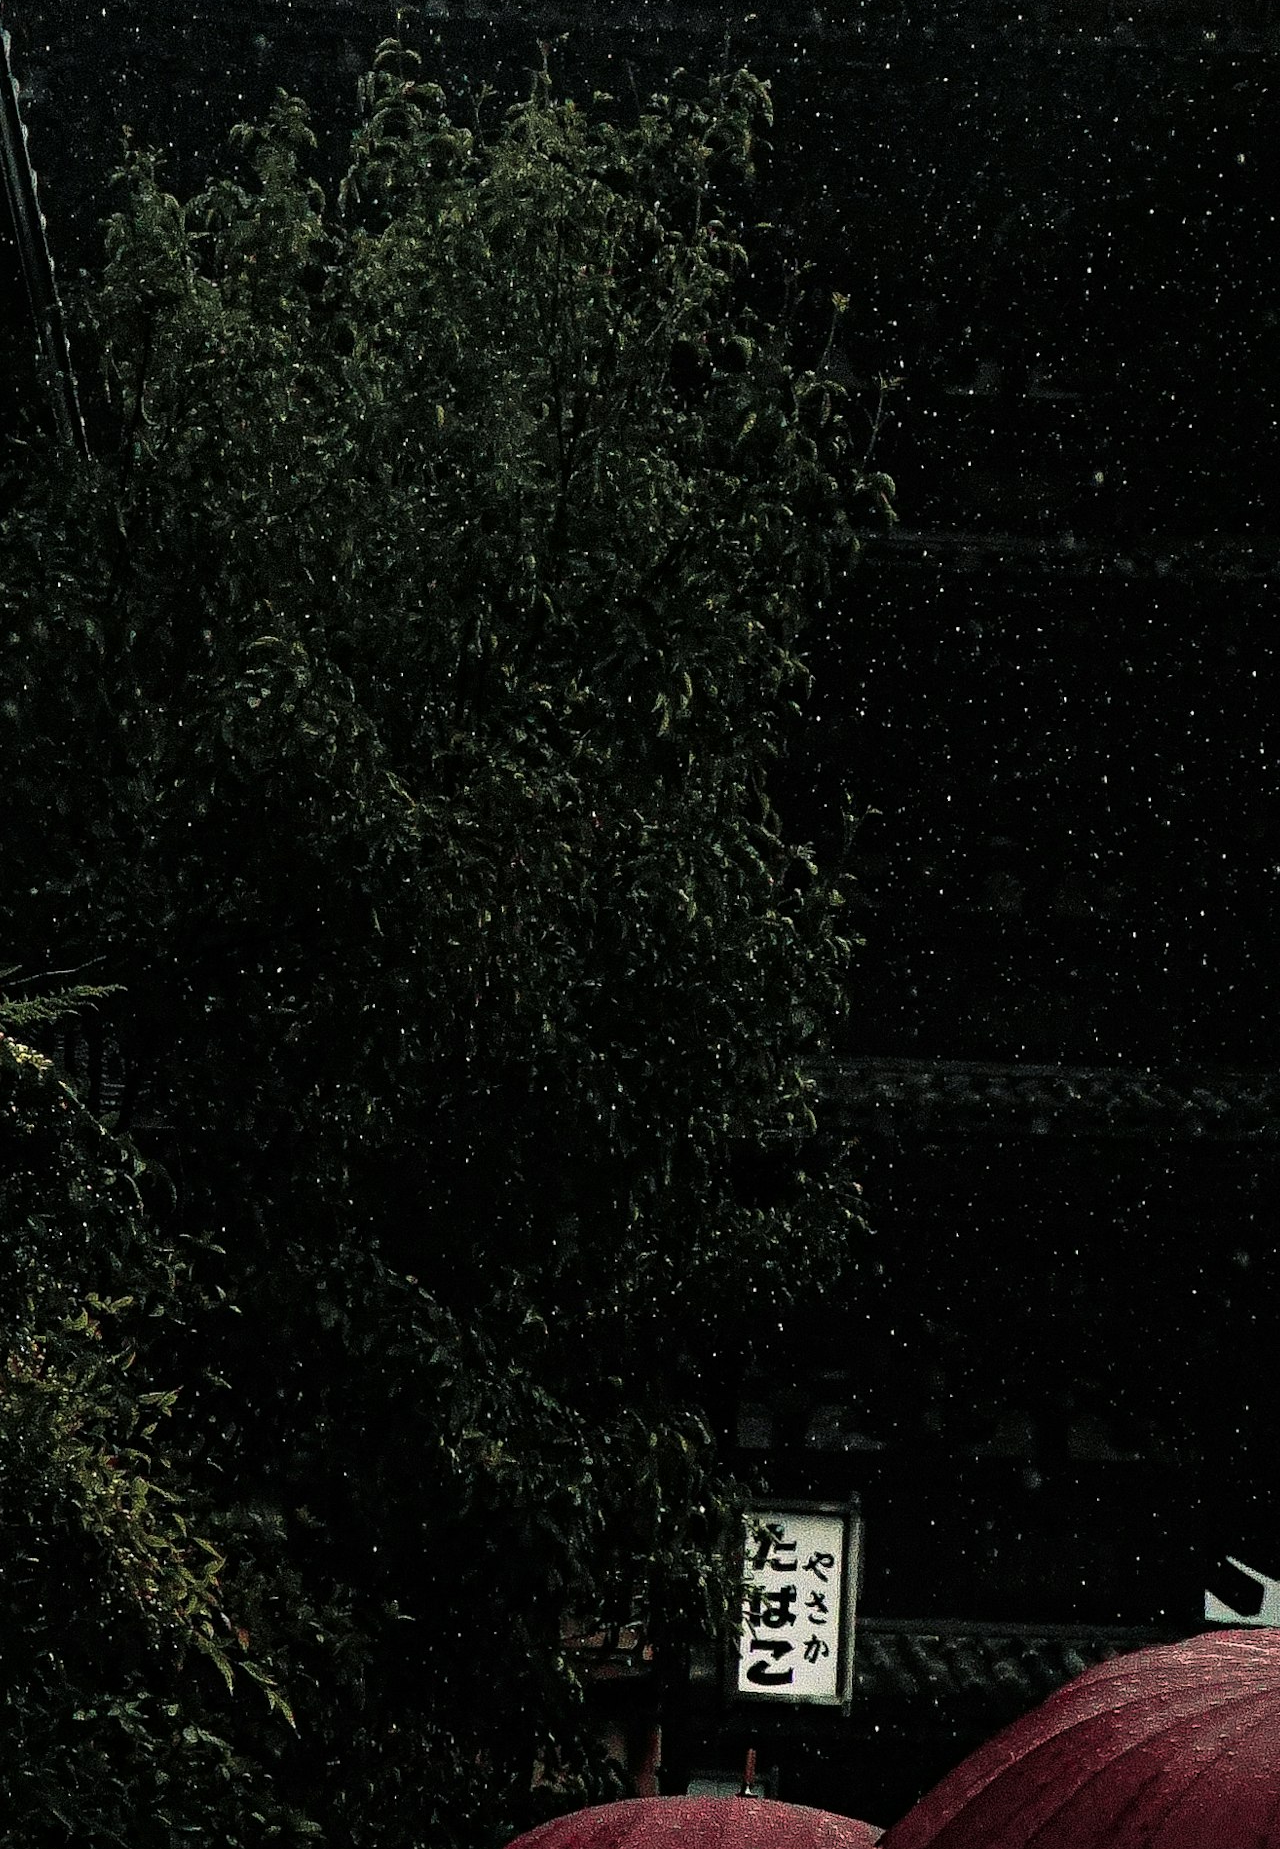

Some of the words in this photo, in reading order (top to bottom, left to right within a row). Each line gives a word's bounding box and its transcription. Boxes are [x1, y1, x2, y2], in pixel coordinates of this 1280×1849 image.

[747, 1522, 798, 1686] たばこ
[802, 1551, 835, 1664] やさか
